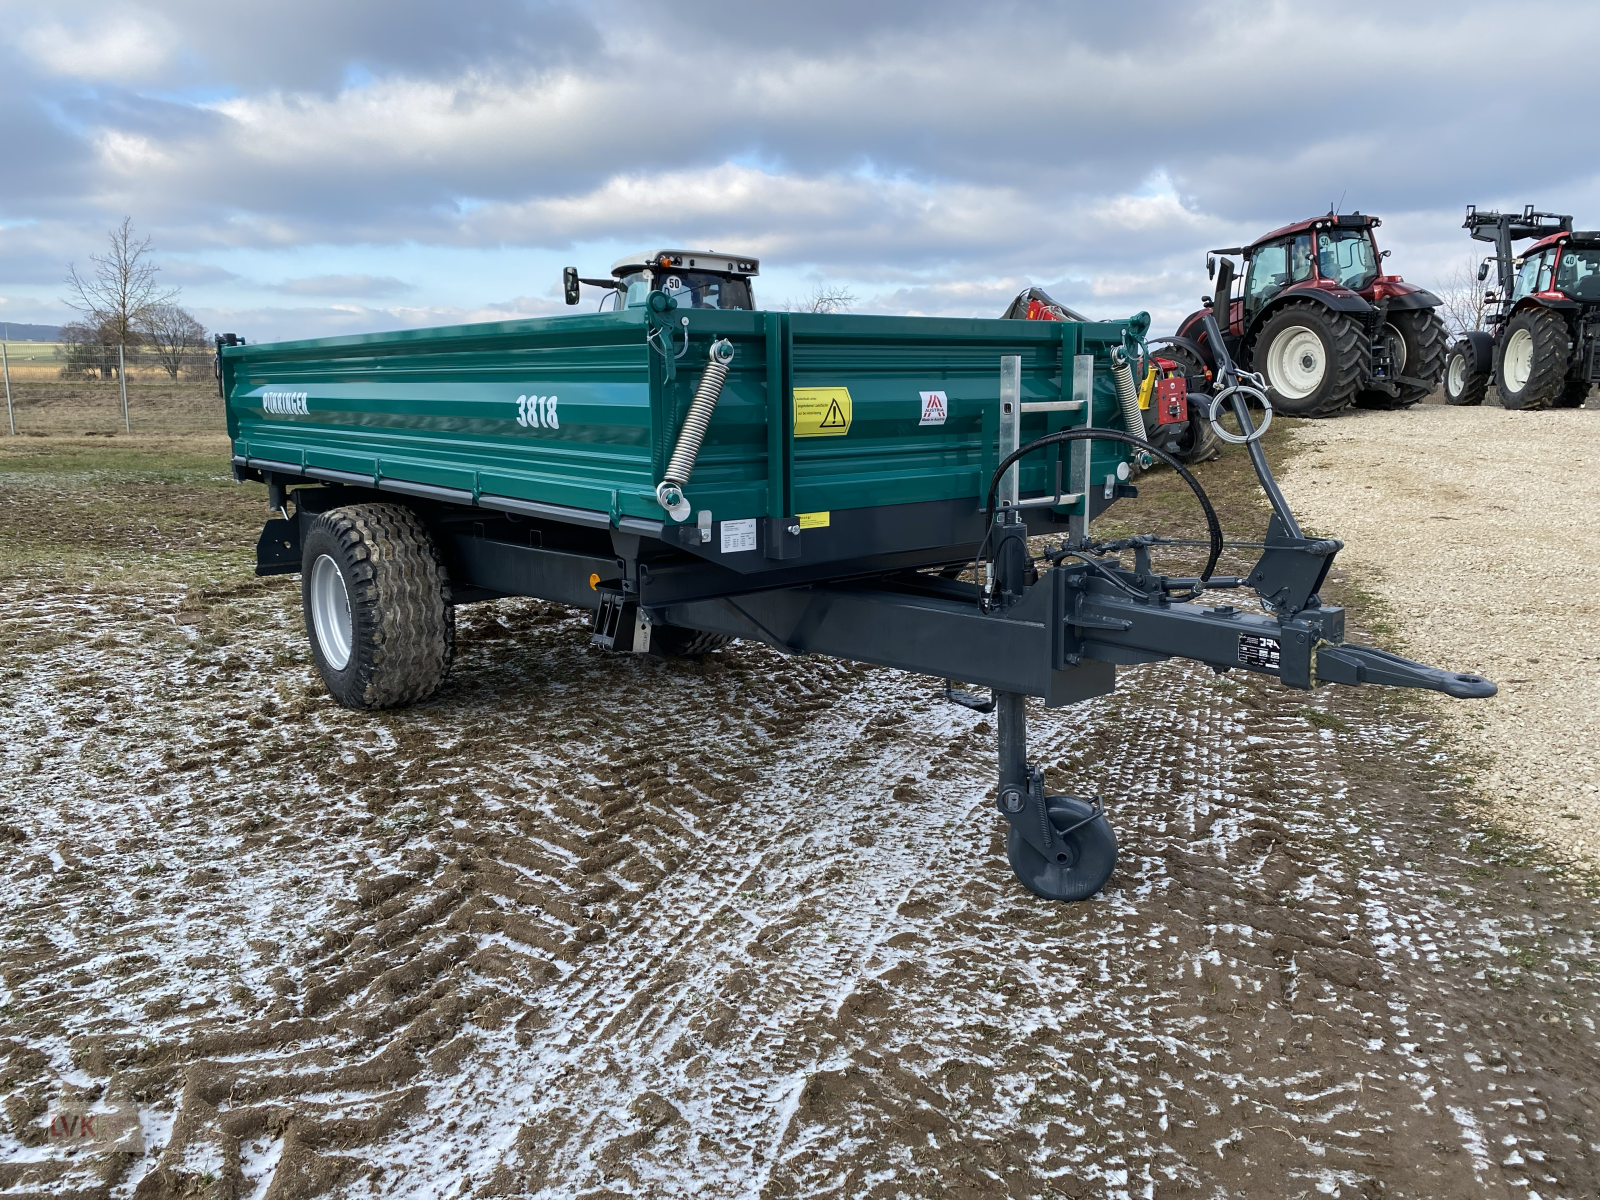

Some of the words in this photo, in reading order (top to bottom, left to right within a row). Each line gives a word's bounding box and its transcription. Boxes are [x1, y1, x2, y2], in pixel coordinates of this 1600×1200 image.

[1321, 237, 1329, 246] 50
[1565, 256, 1575, 265] 40
[669, 278, 680, 289] 50
[515, 394, 560, 430] 3818
